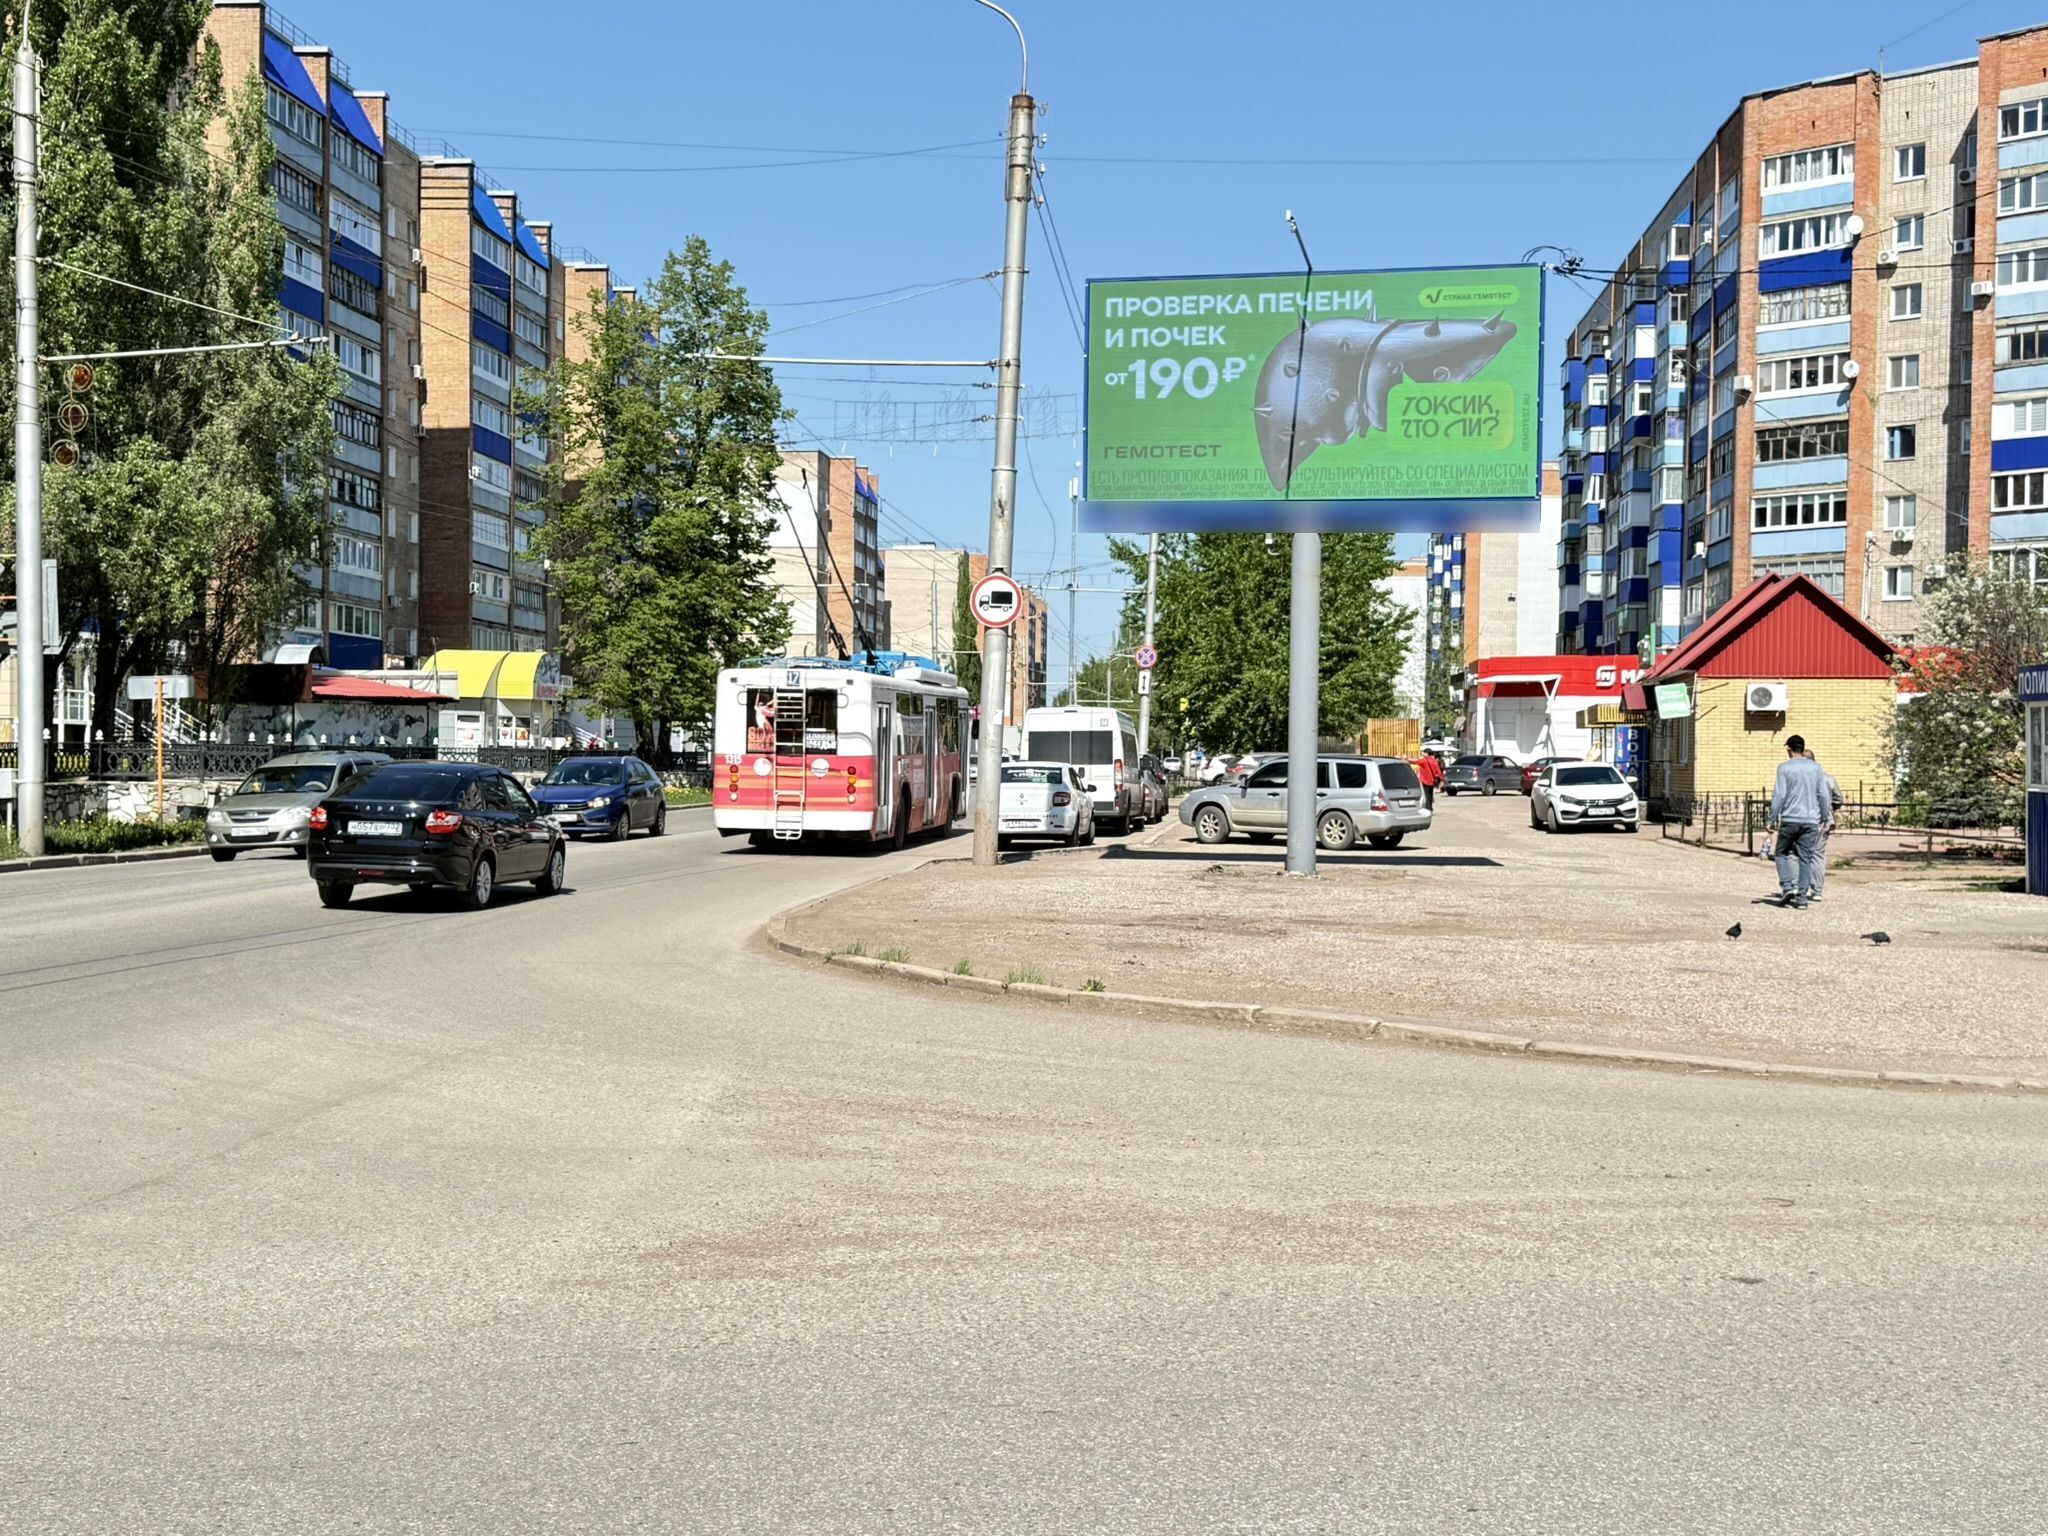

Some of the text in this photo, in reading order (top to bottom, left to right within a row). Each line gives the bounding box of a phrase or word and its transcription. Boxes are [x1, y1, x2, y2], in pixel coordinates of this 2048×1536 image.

[1105, 289, 1373, 318] ПРОВЕРКА ПЕЧЕНИ
[1473, 292, 1512, 300] ГЕМОТЕСТ
[1105, 325, 1226, 348] И ПОЧЕК
[1104, 372, 1128, 385] от
[1402, 395, 1500, 417] ТОКСИК,
[1444, 417, 1500, 437] ЛИ?
[1104, 445, 1222, 459] ГЕМОТЕСТ
[1092, 470, 1120, 484] ЕСТЬ
[1406, 465, 1423, 480] СО
[1425, 463, 1529, 480] СПЕЦИАЛИСТОМ
[788, 672, 800, 686] 17
